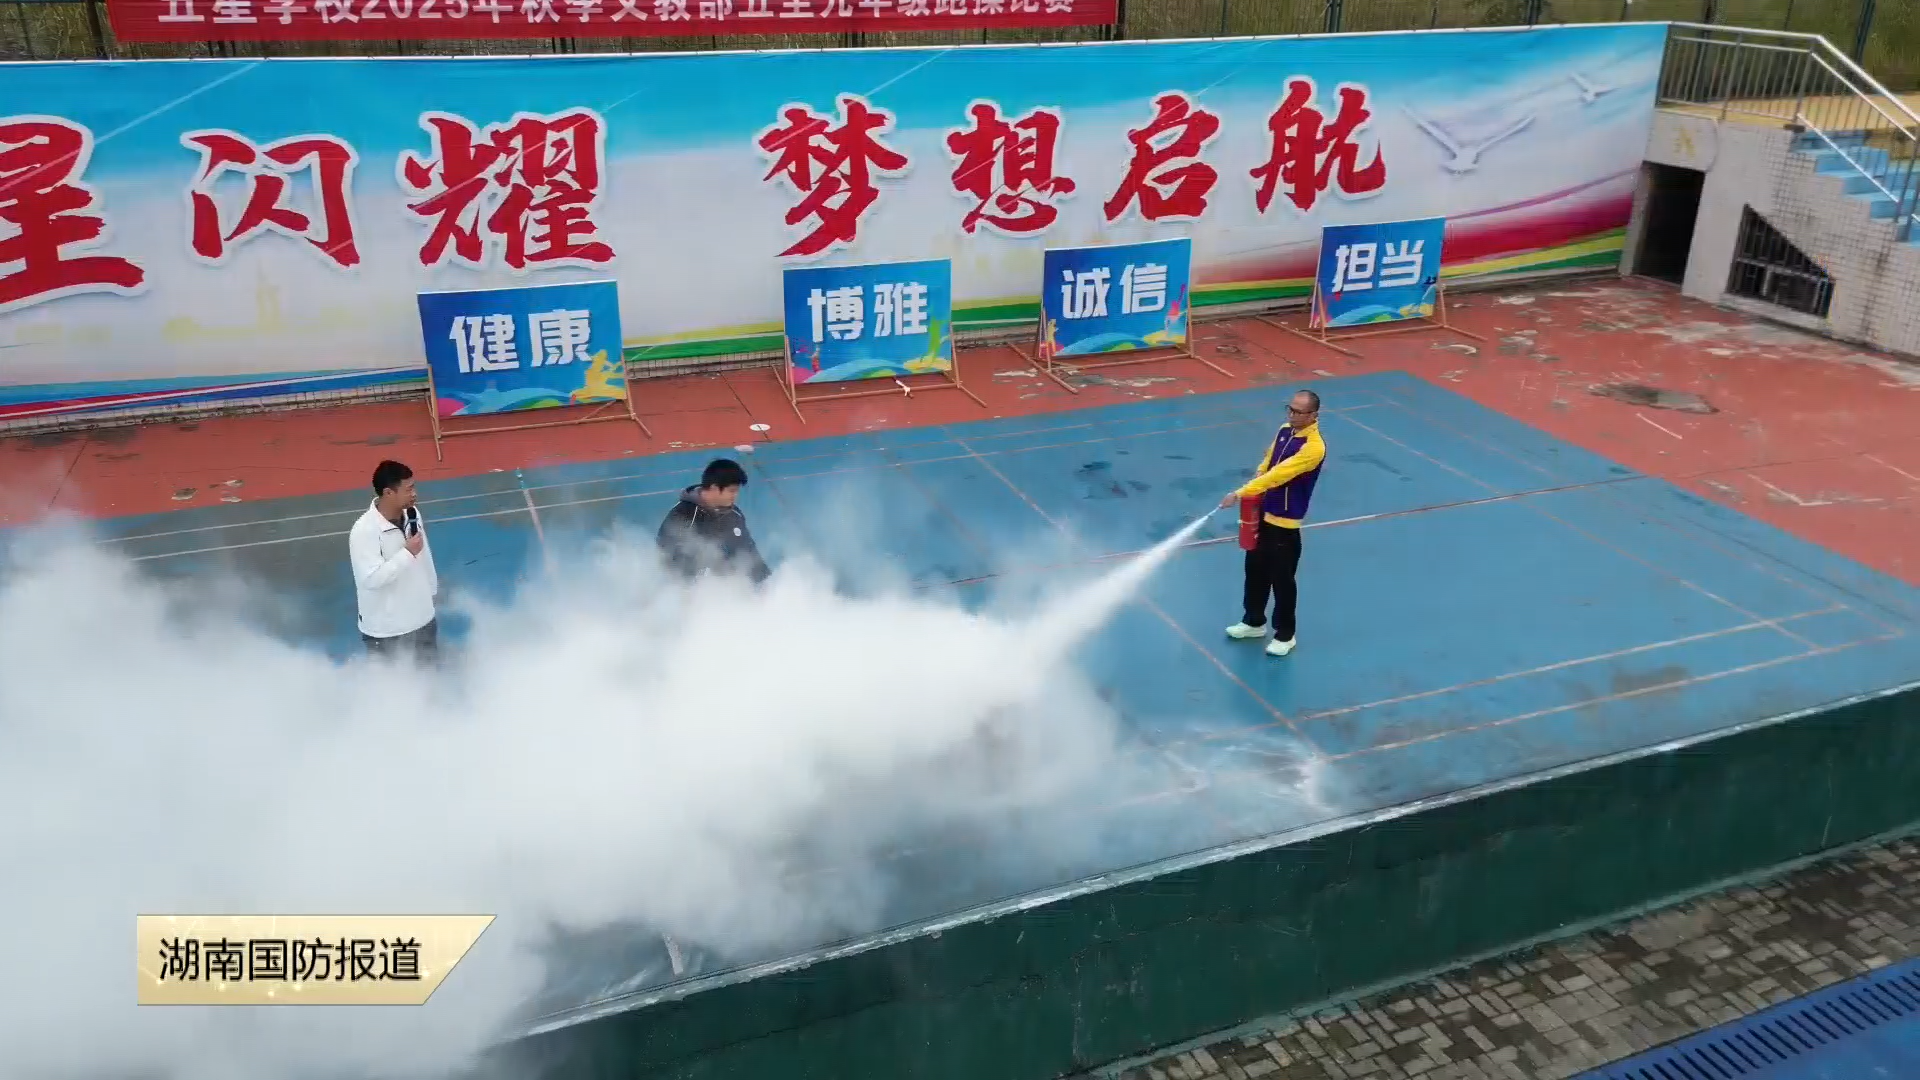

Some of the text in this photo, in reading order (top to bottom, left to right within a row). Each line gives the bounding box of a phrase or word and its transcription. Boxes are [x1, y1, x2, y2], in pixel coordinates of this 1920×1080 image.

[758, 80, 1387, 258] 梦想启航
[1061, 264, 1168, 320] 诚信
[1332, 240, 1425, 293] 担当
[449, 308, 593, 373] 健康
[807, 281, 929, 343] 博雅
